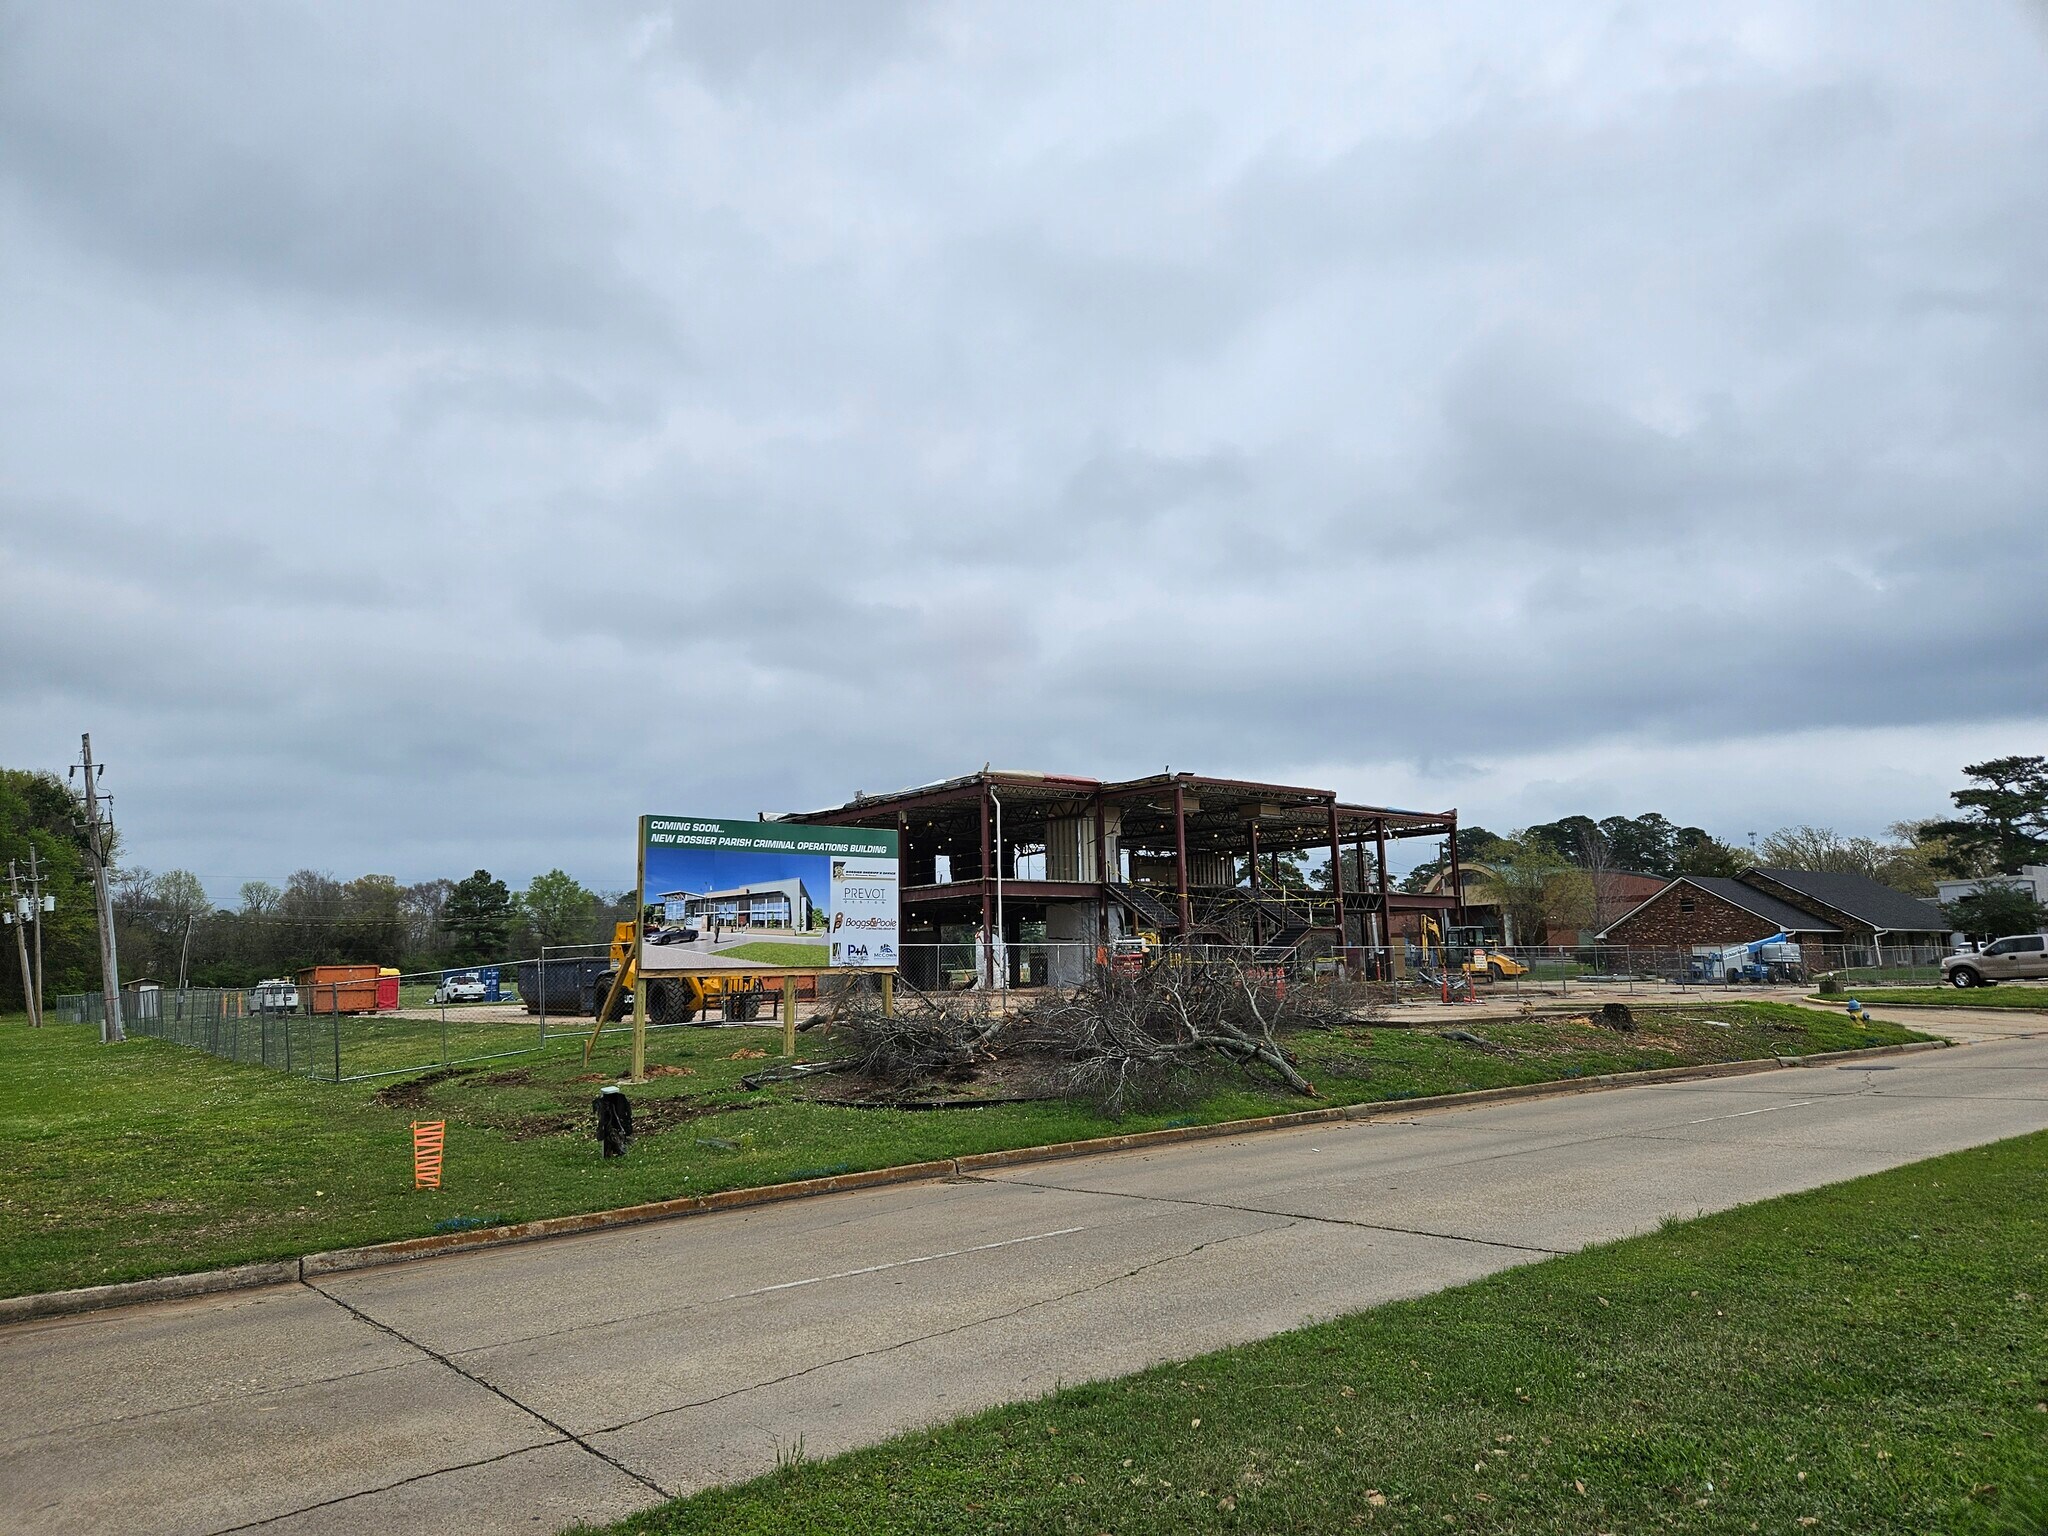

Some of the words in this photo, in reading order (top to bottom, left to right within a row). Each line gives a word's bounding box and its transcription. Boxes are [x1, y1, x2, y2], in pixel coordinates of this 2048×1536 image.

[651, 821, 691, 831] COMING
[692, 823, 725, 833] SOON...
[651, 833, 676, 843] NEW
[676, 835, 717, 845] BOSSIER
[718, 837, 753, 847] PARISH
[753, 839, 796, 849] CRIMINAL
[797, 841, 849, 852] OPERATIONS
[850, 844, 887, 854] BUILDING
[845, 888, 885, 899] PREVOT
